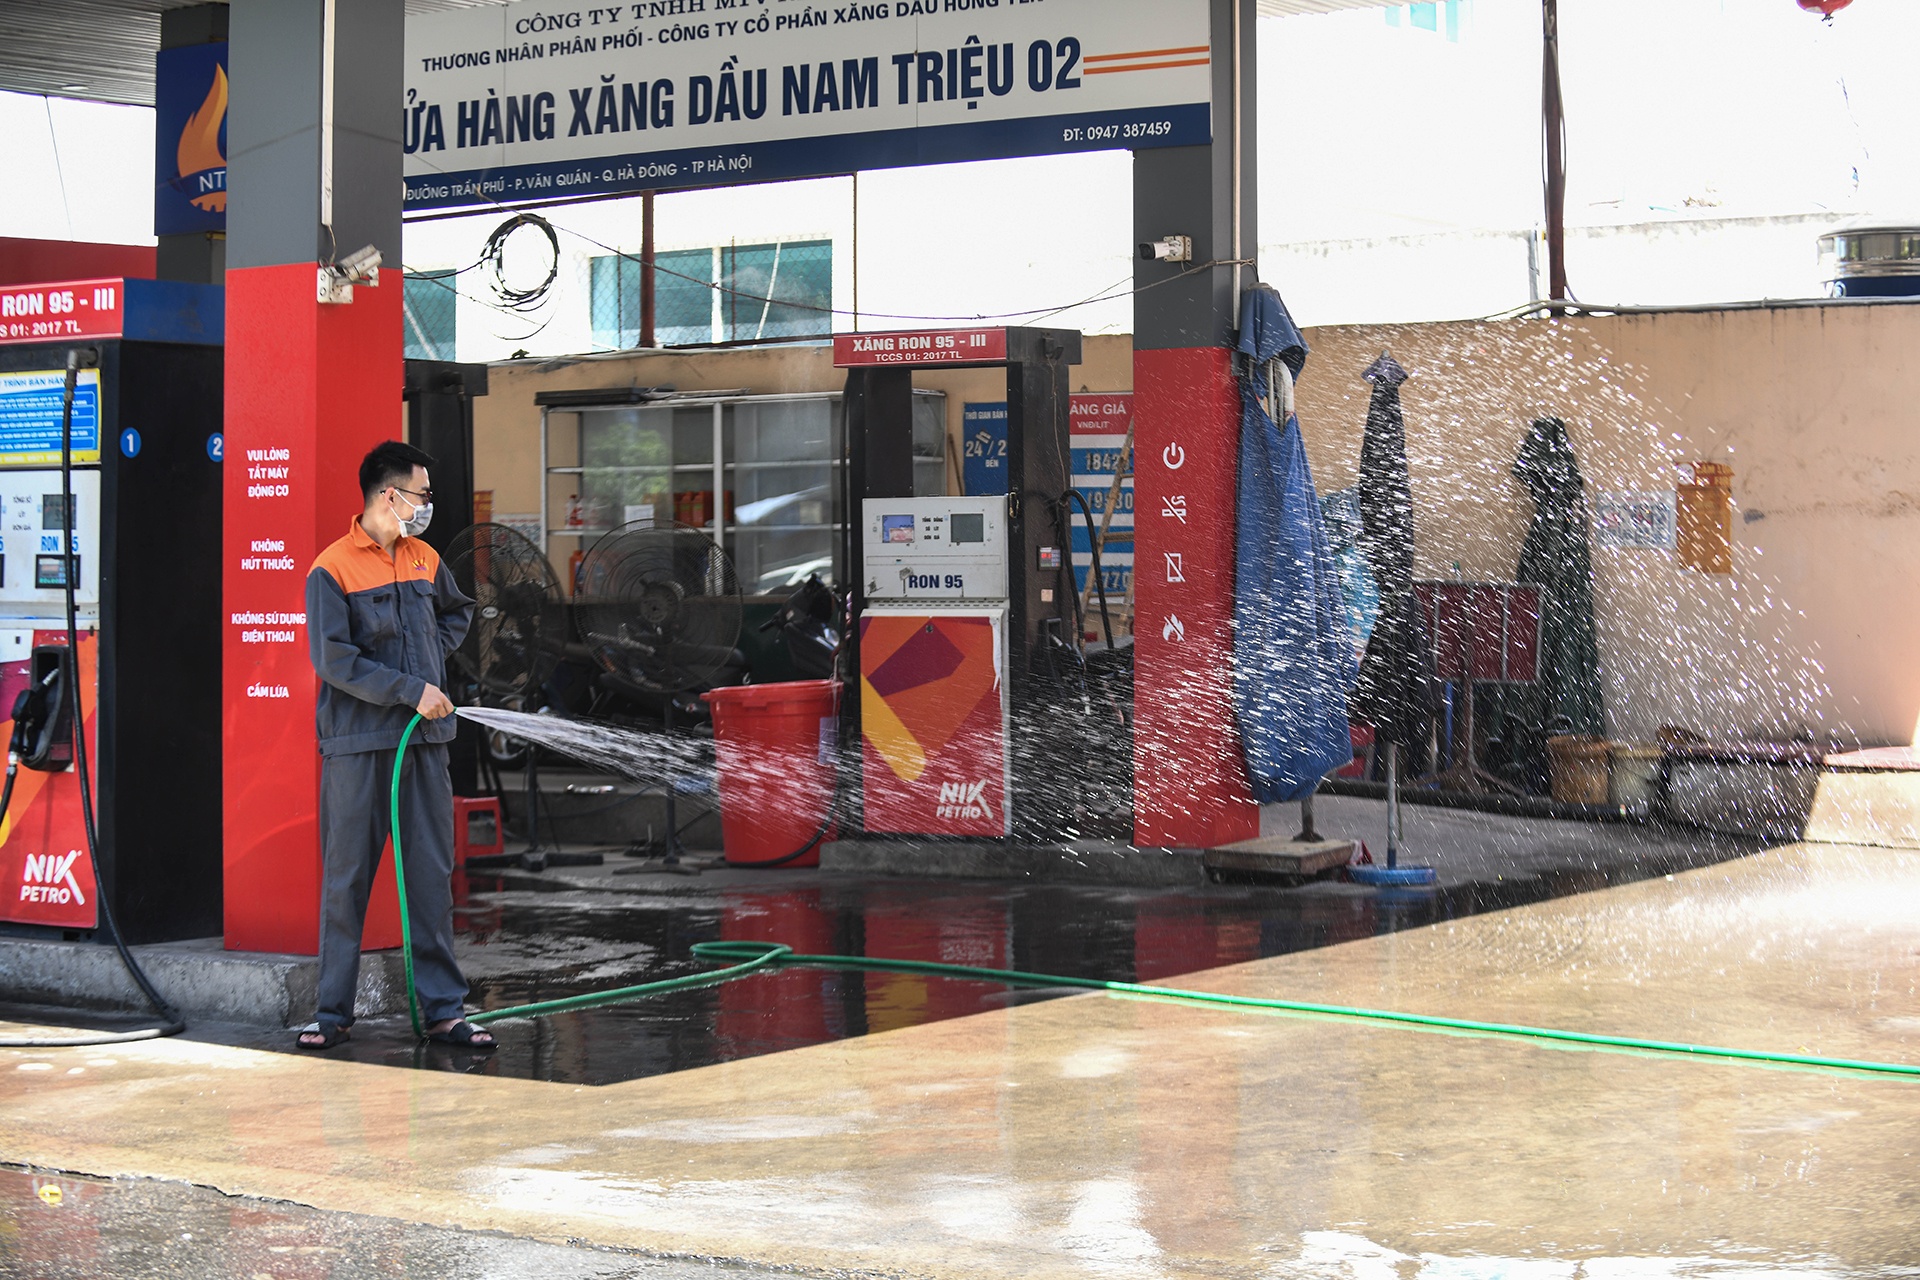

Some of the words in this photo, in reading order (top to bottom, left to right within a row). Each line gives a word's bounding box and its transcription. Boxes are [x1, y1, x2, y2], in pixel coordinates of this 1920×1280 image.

[515, 12, 582, 34] CÔNG
[589, 7, 623, 26] TY
[632, 0, 707, 19] TNHH
[422, 51, 490, 72] THƯƠNG
[496, 38, 544, 63] NHÂN
[549, 35, 597, 57] PHÂN
[602, 26, 643, 50] PHỐI
[658, 23, 710, 44] CÔNG
[715, 20, 738, 37] TY
[744, 9, 770, 34] CỔ
[776, 5, 828, 31] PHẦN
[834, 2, 889, 25] XĂNG
[404, 88, 446, 154] ỬA
[457, 88, 555, 149] HÀNG
[568, 74, 674, 137] XĂNG
[688, 55, 767, 126] DẦU
[782, 56, 879, 117] NAM
[892, 35, 1014, 110] TRIỆU
[1027, 36, 1081, 91] 02
[1063, 127, 1084, 141] ĐT:
[1087, 125, 1119, 140] 0947
[1122, 121, 1171, 138] 387459
[199, 171, 227, 192] NT
[407, 183, 449, 200] ĐƯỜNG
[483, 176, 505, 193] PHÚ
[556, 169, 592, 186] QUÁN
[617, 163, 635, 180] HÀ
[638, 162, 678, 178] ĐÔNG
[692, 160, 705, 173] TP
[707, 155, 726, 172] HÀ
[729, 154, 752, 173] NỘI
[2, 293, 44, 317] RON
[48, 290, 75, 314] 95
[32, 320, 62, 336] 2017
[65, 319, 82, 333] TL
[852, 336, 894, 352] XĂNG
[898, 335, 931, 350] RON
[935, 335, 955, 348] 95
[874, 353, 903, 362] TCCS
[922, 351, 947, 360] 2017
[949, 350, 962, 359] TL
[1102, 400, 1127, 415] GIÁ
[127, 433, 134, 452] 1
[213, 437, 223, 456] 2
[247, 449, 263, 461] VUI
[41, 536, 59, 551] RON
[908, 574, 940, 588] RON
[944, 574, 963, 588] 95
[24, 850, 85, 906] NIK
[20, 885, 71, 904] PETRO
